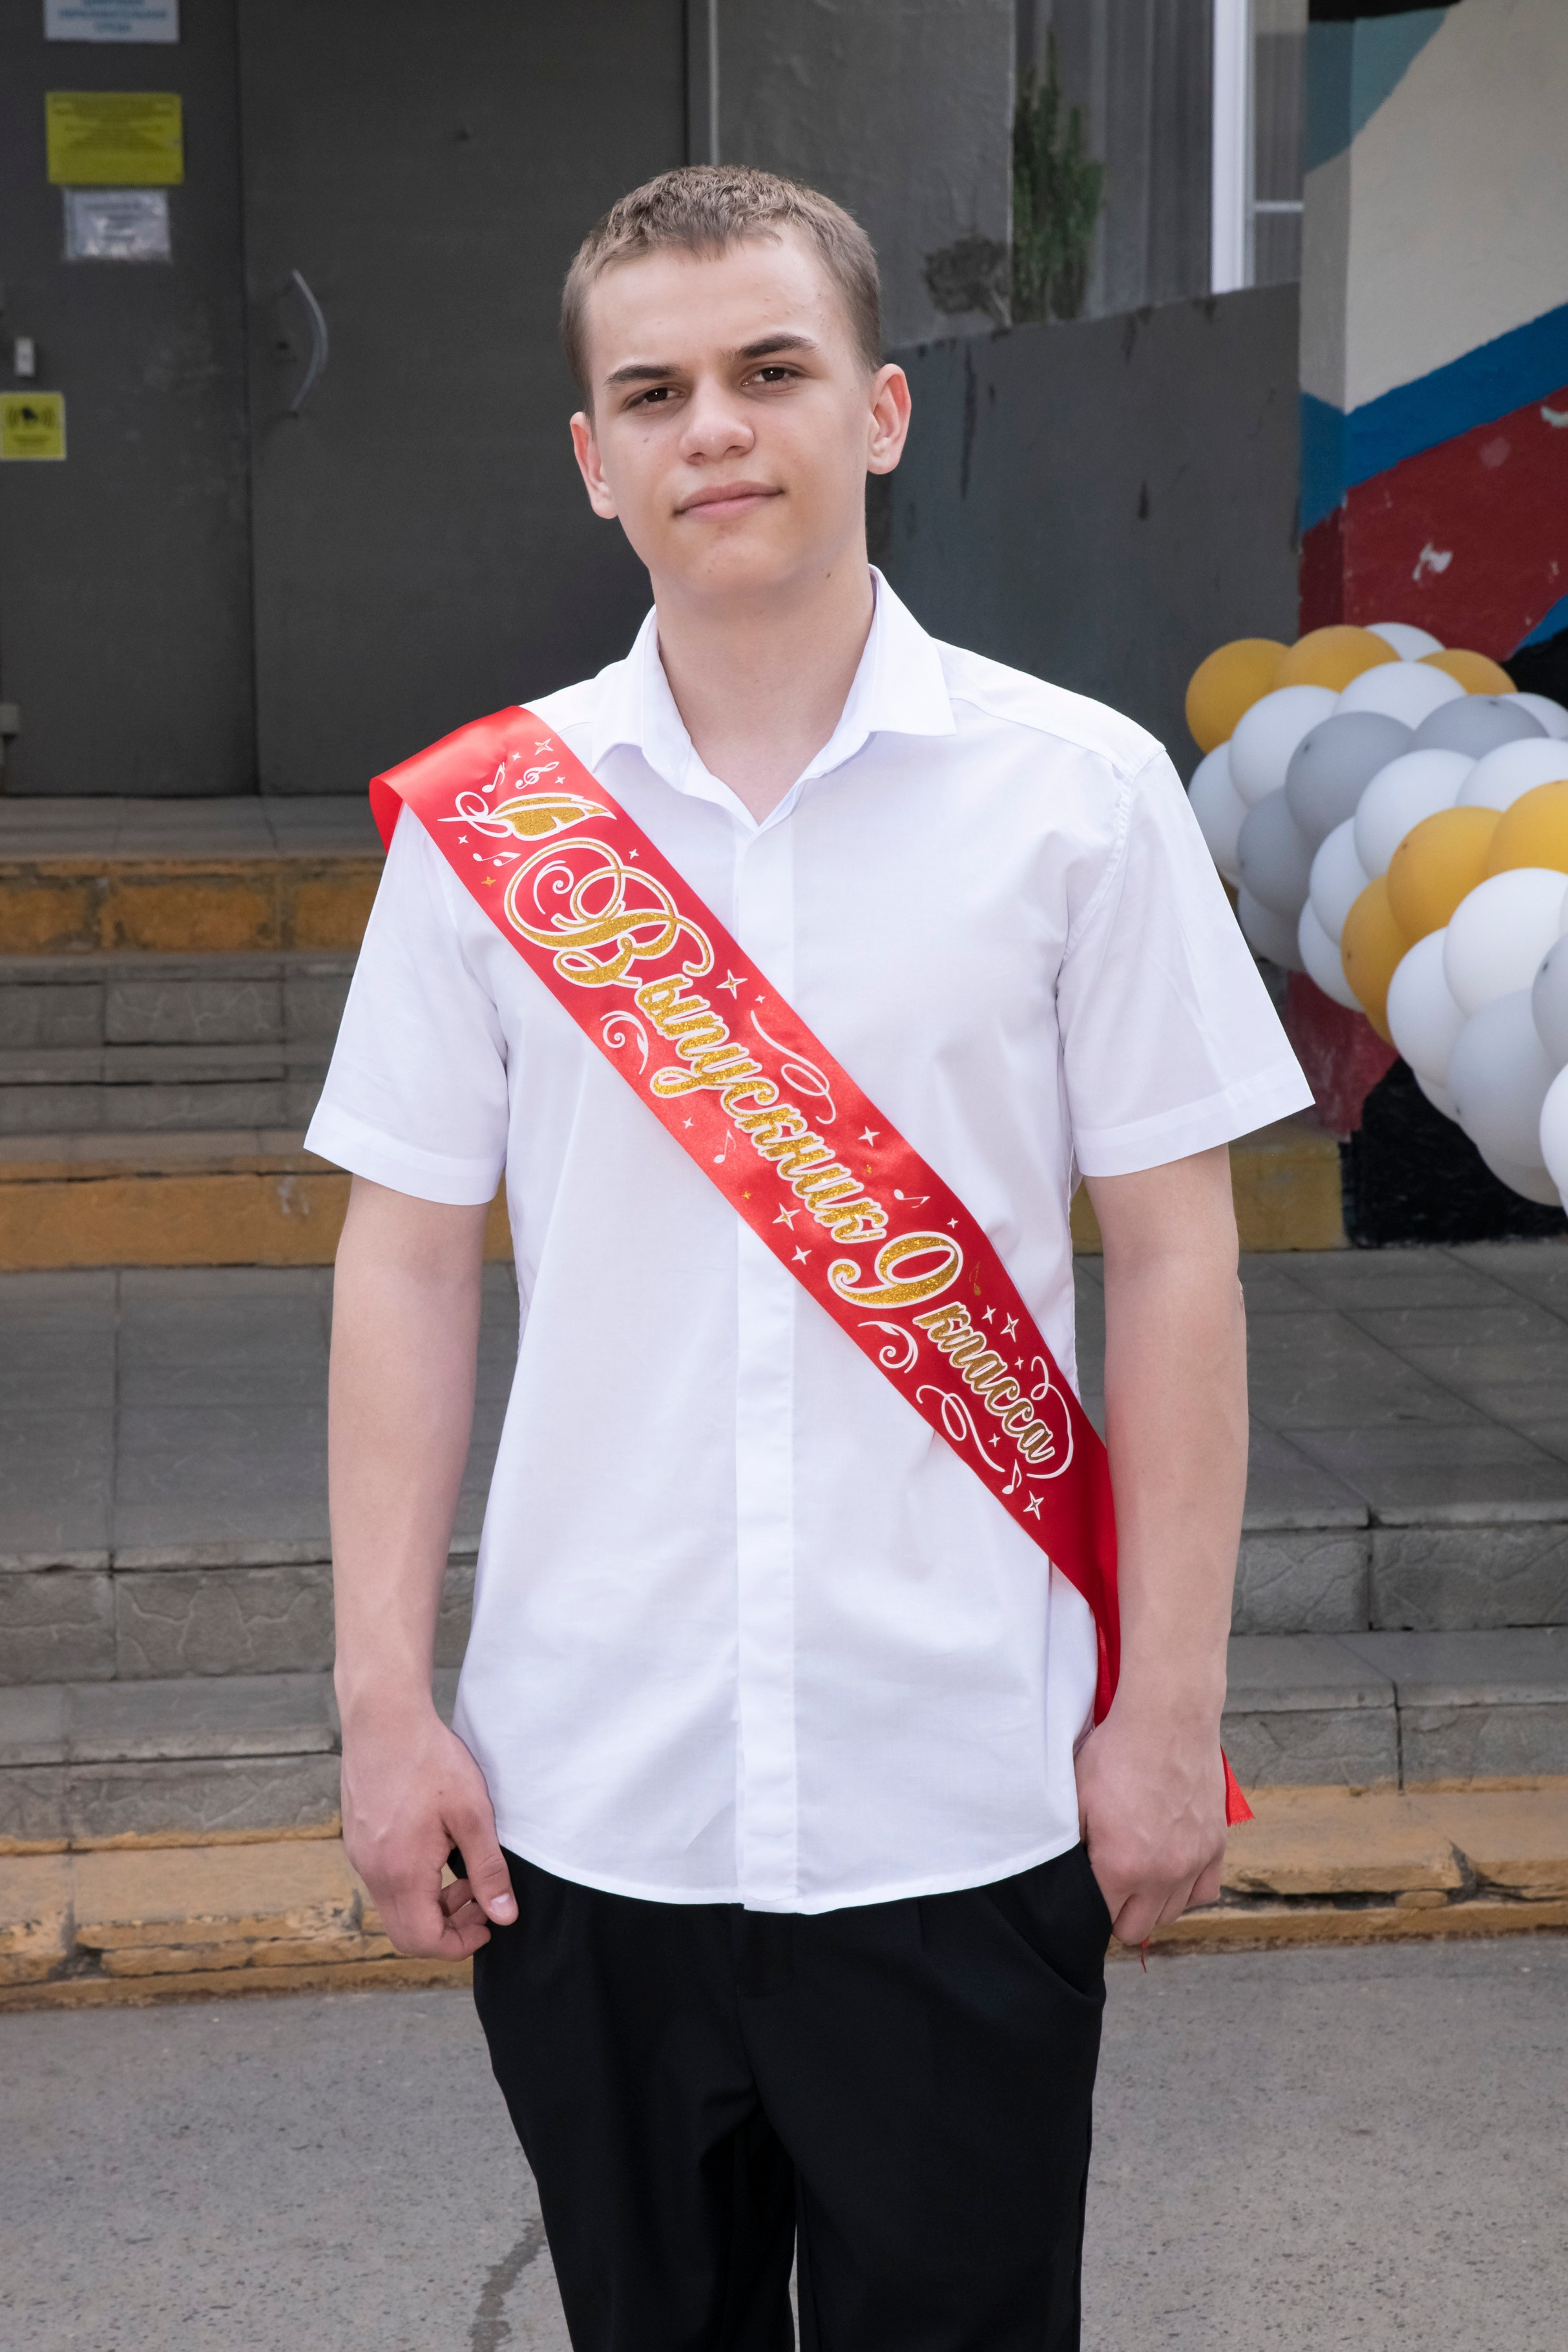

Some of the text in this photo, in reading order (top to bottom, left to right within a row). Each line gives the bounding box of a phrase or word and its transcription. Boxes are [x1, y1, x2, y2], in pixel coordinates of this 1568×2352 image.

[505, 837, 1055, 1464] Выпускник 9 класса
